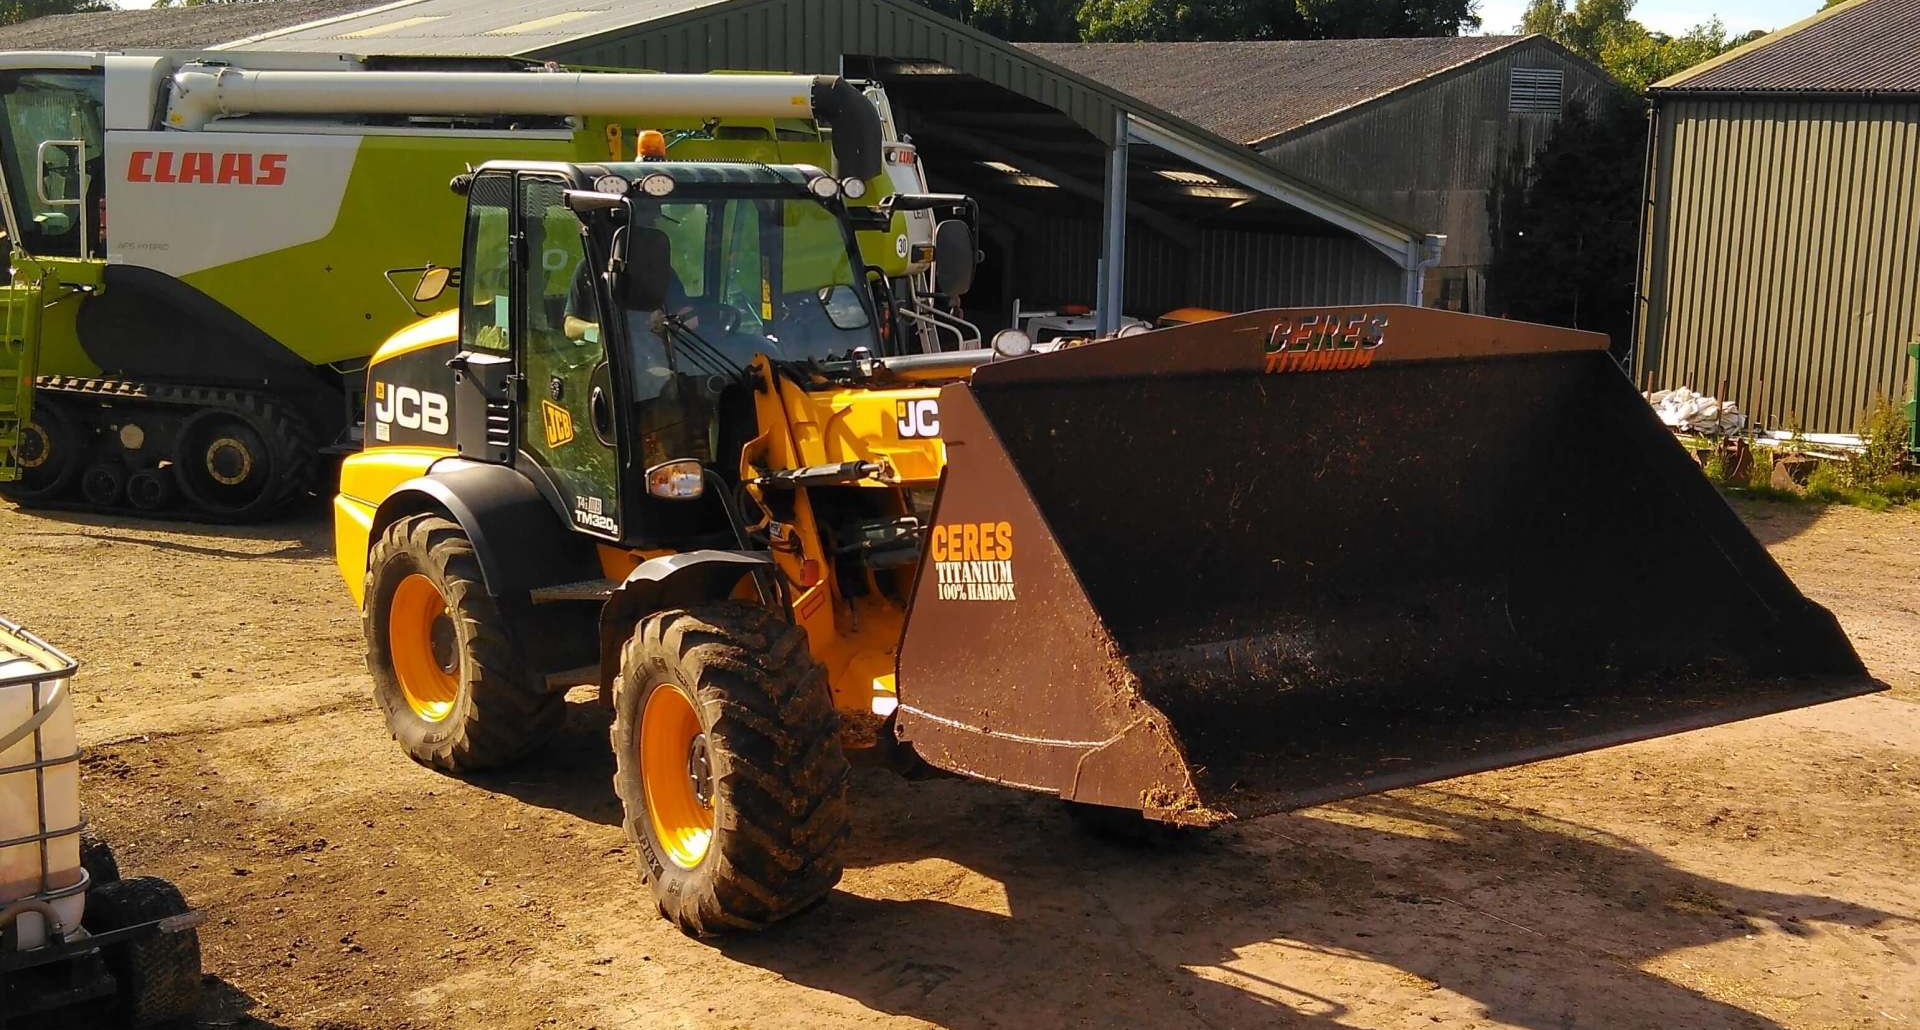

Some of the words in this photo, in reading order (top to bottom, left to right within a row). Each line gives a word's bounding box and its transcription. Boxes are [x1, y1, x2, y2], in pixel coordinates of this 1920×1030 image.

[127, 152, 288, 186] CLAAS
[898, 238, 907, 253] 30
[1264, 313, 1388, 354] CERES
[1264, 349, 1376, 374] TITANIUM
[375, 383, 449, 436] JCB
[547, 406, 571, 444] JCB
[898, 400, 940, 437] JC
[932, 521, 1013, 562] CERES
[935, 560, 1013, 583] TITANIUM
[938, 583, 967, 600] 100%
[967, 583, 1017, 600] HARDOX
